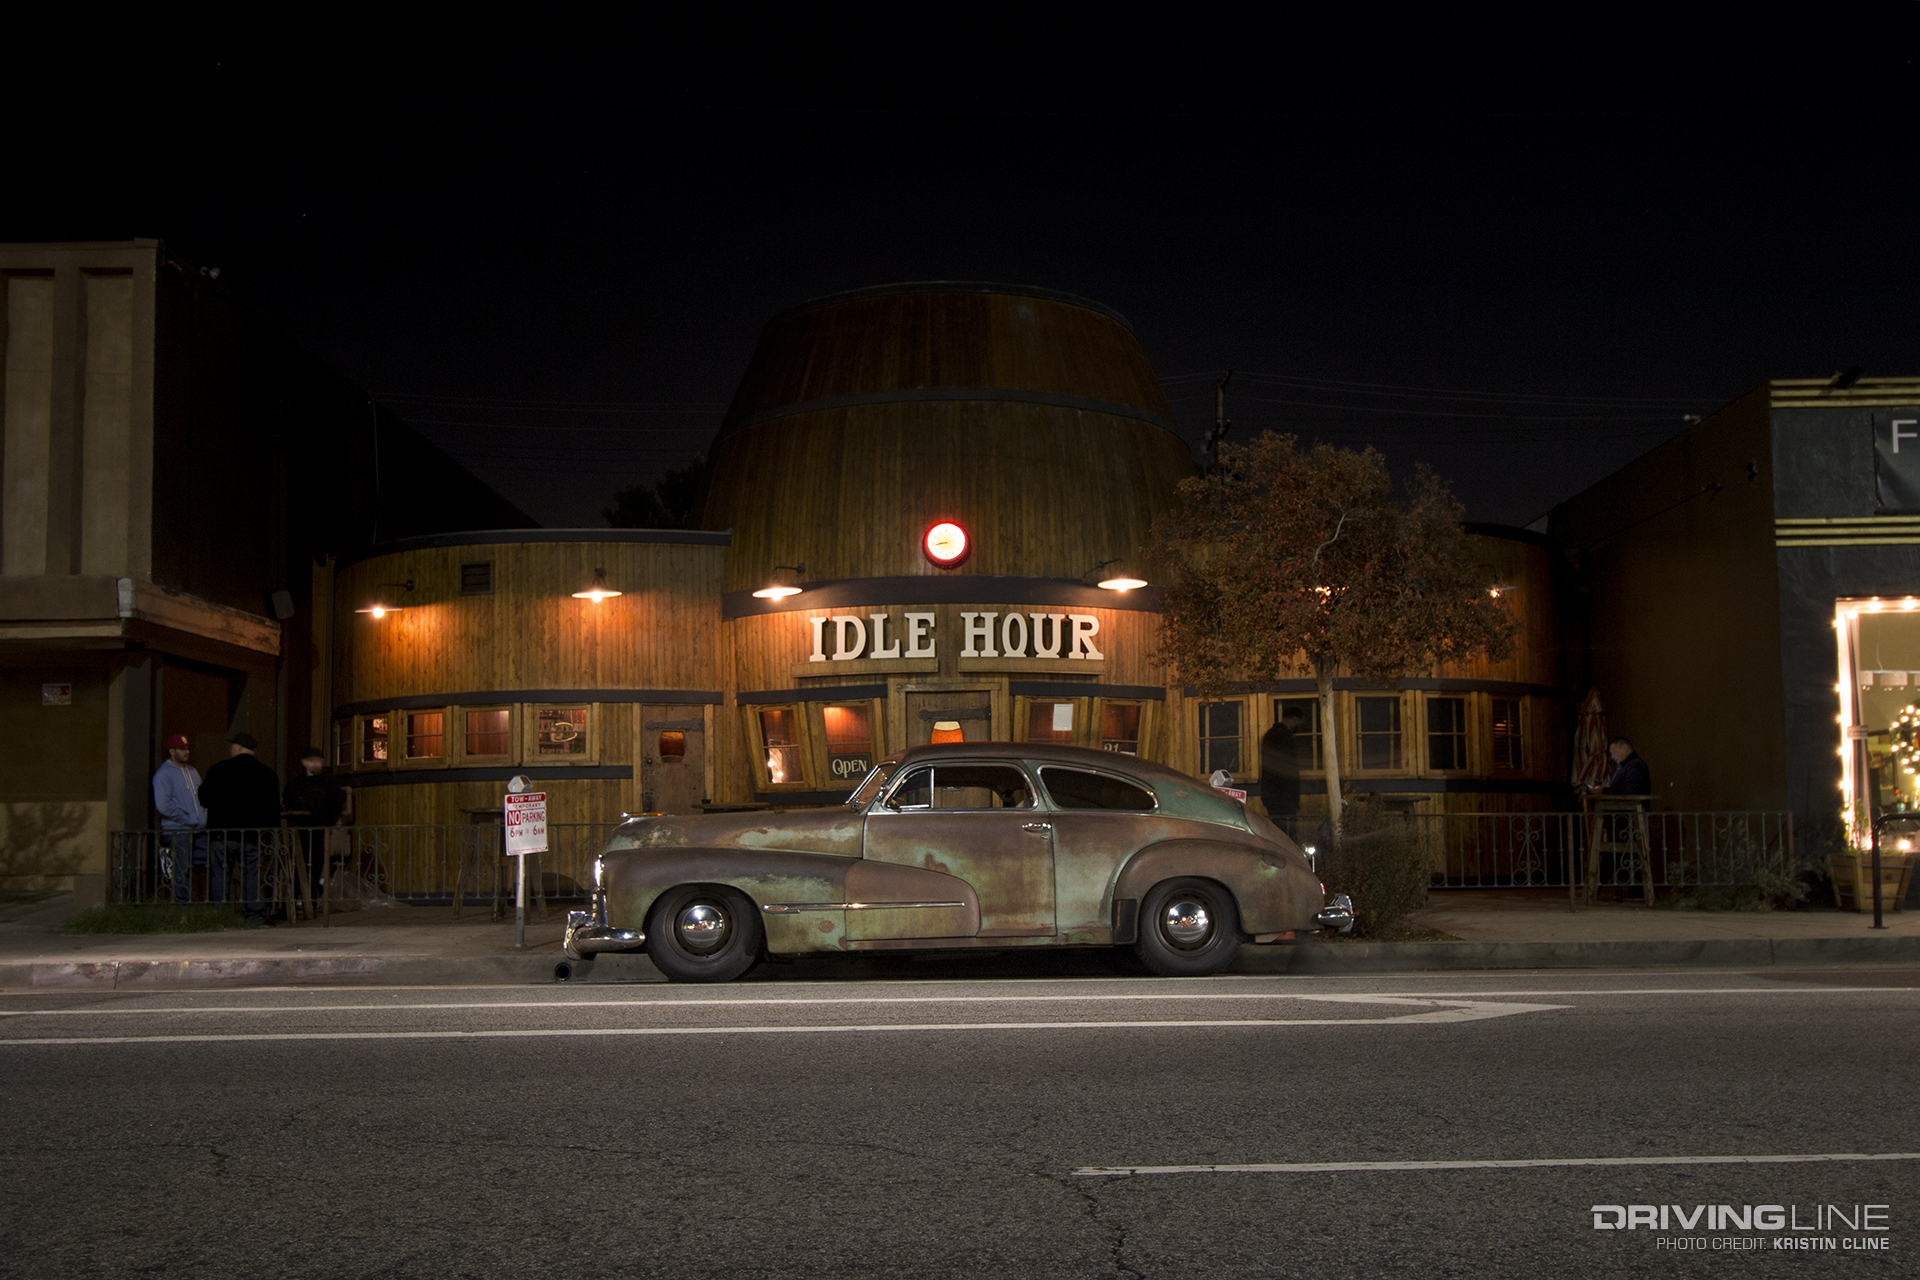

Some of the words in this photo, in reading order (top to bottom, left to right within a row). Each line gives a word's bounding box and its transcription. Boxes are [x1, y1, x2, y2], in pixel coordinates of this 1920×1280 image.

[809, 611, 936, 662] IDLE
[959, 611, 1104, 660] HOUR
[511, 795, 542, 803] TOW-AWAY
[508, 811, 520, 825] NO
[522, 811, 545, 823] PARKING
